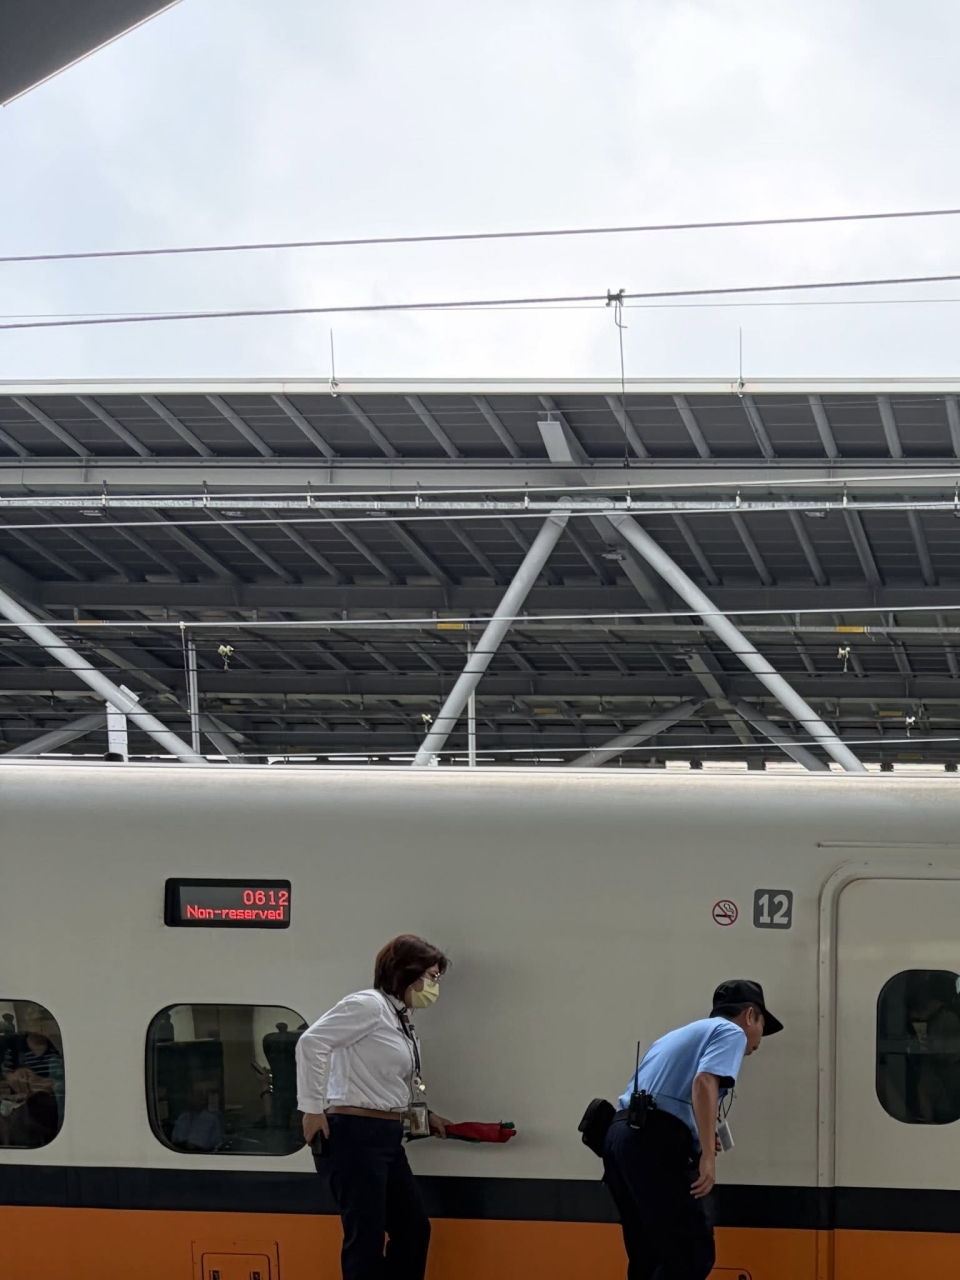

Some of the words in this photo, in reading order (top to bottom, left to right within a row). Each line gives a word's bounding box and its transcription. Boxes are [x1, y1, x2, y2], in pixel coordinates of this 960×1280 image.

[243, 890, 289, 906] 0612
[186, 905, 284, 920] Non-reserved
[758, 894, 789, 924] 12
